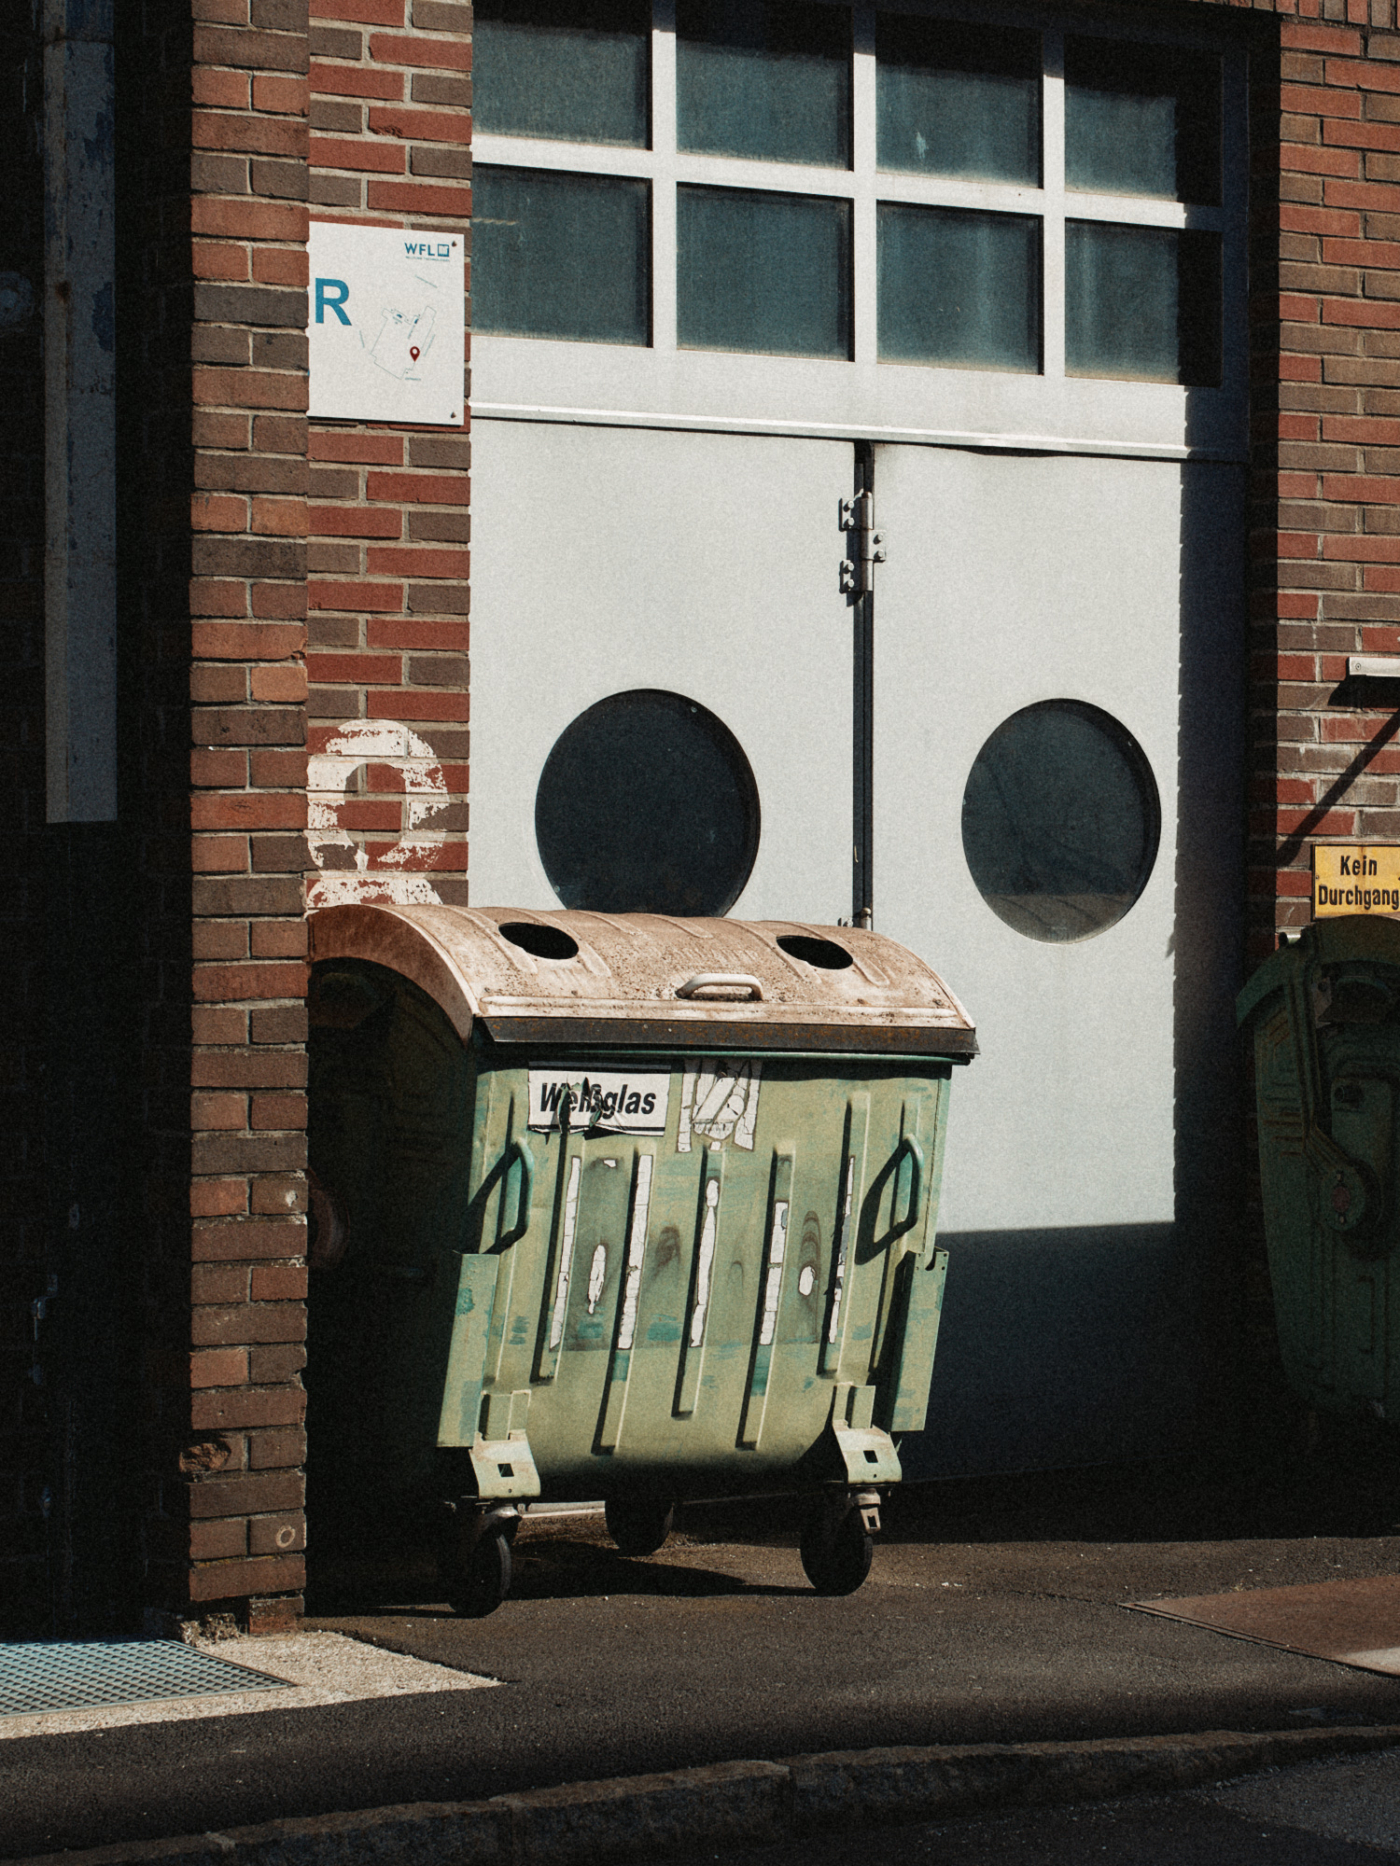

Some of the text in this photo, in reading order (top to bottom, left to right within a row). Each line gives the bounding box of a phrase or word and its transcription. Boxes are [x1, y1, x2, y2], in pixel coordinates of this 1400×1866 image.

[405, 242, 435, 256] WFL
[1340, 855, 1377, 876] Kein
[1318, 885, 1399, 910] Durchgang
